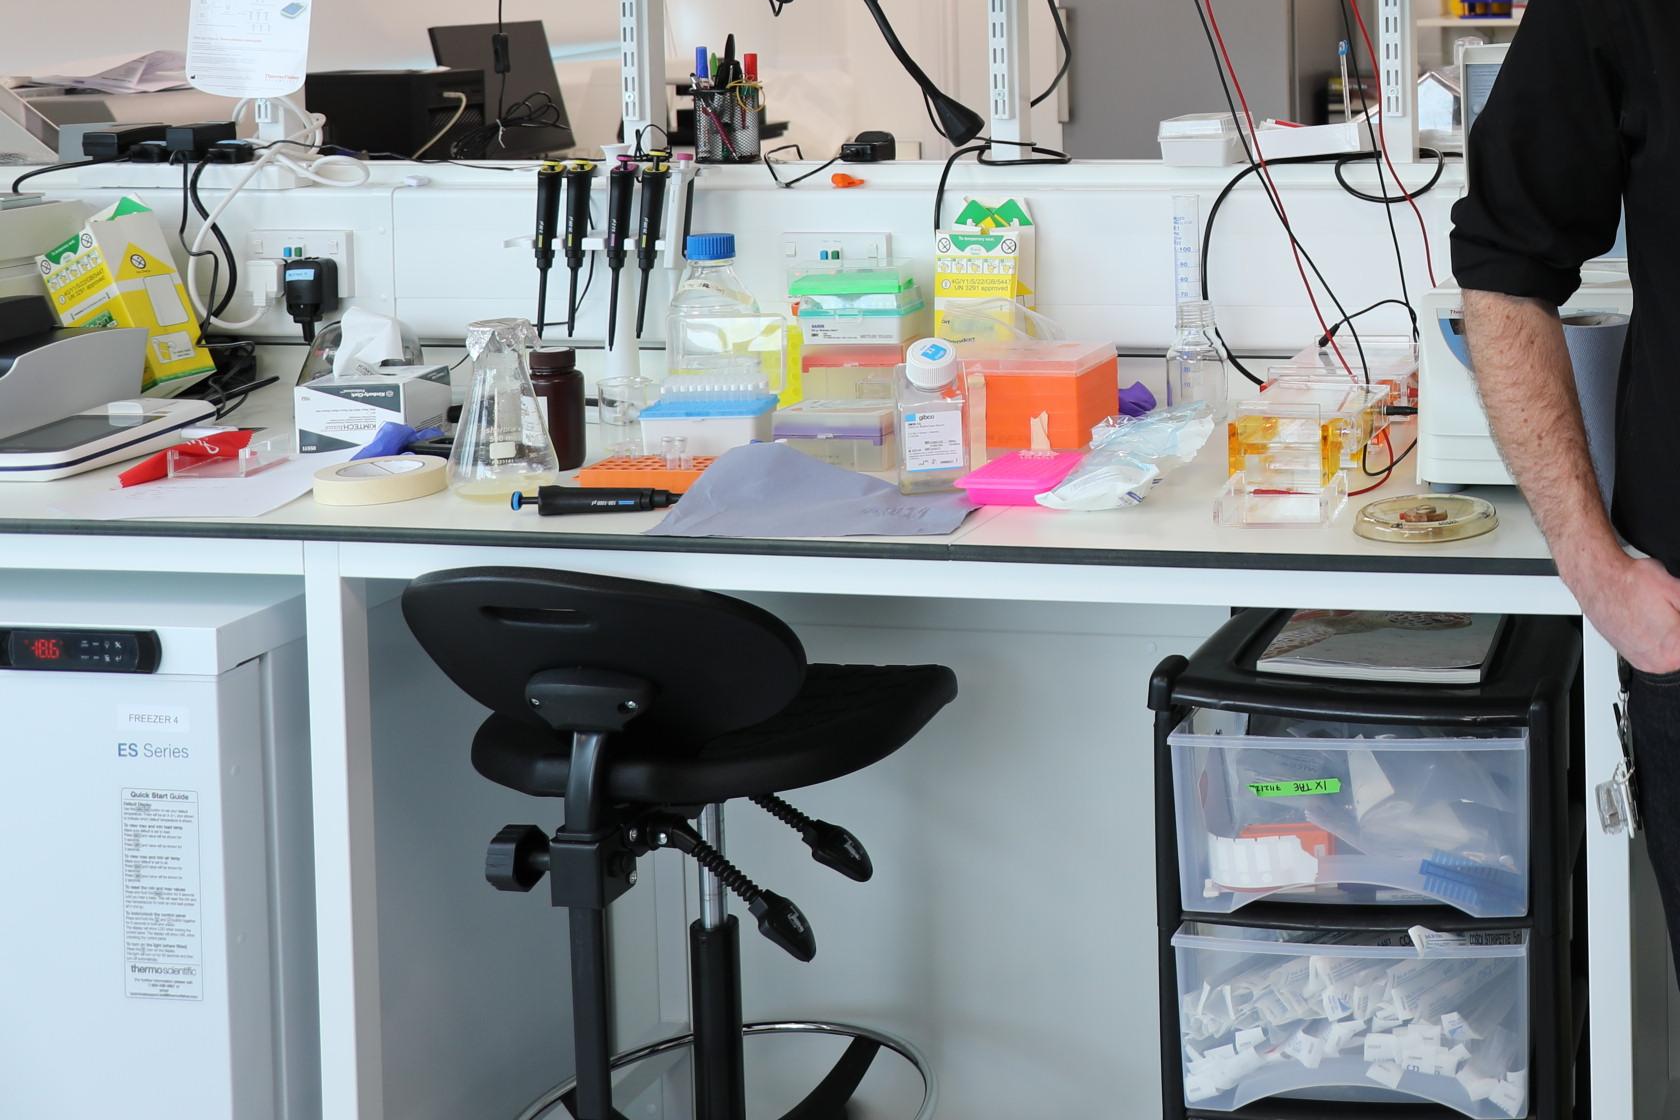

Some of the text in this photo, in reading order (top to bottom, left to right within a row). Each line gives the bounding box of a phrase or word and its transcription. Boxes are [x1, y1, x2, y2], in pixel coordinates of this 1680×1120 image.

[981, 284, 1008, 292] approved
[128, 714, 179, 725] FREEZER 4
[118, 742, 190, 759] ES Series
[130, 791, 189, 801] Quick Start Guide
